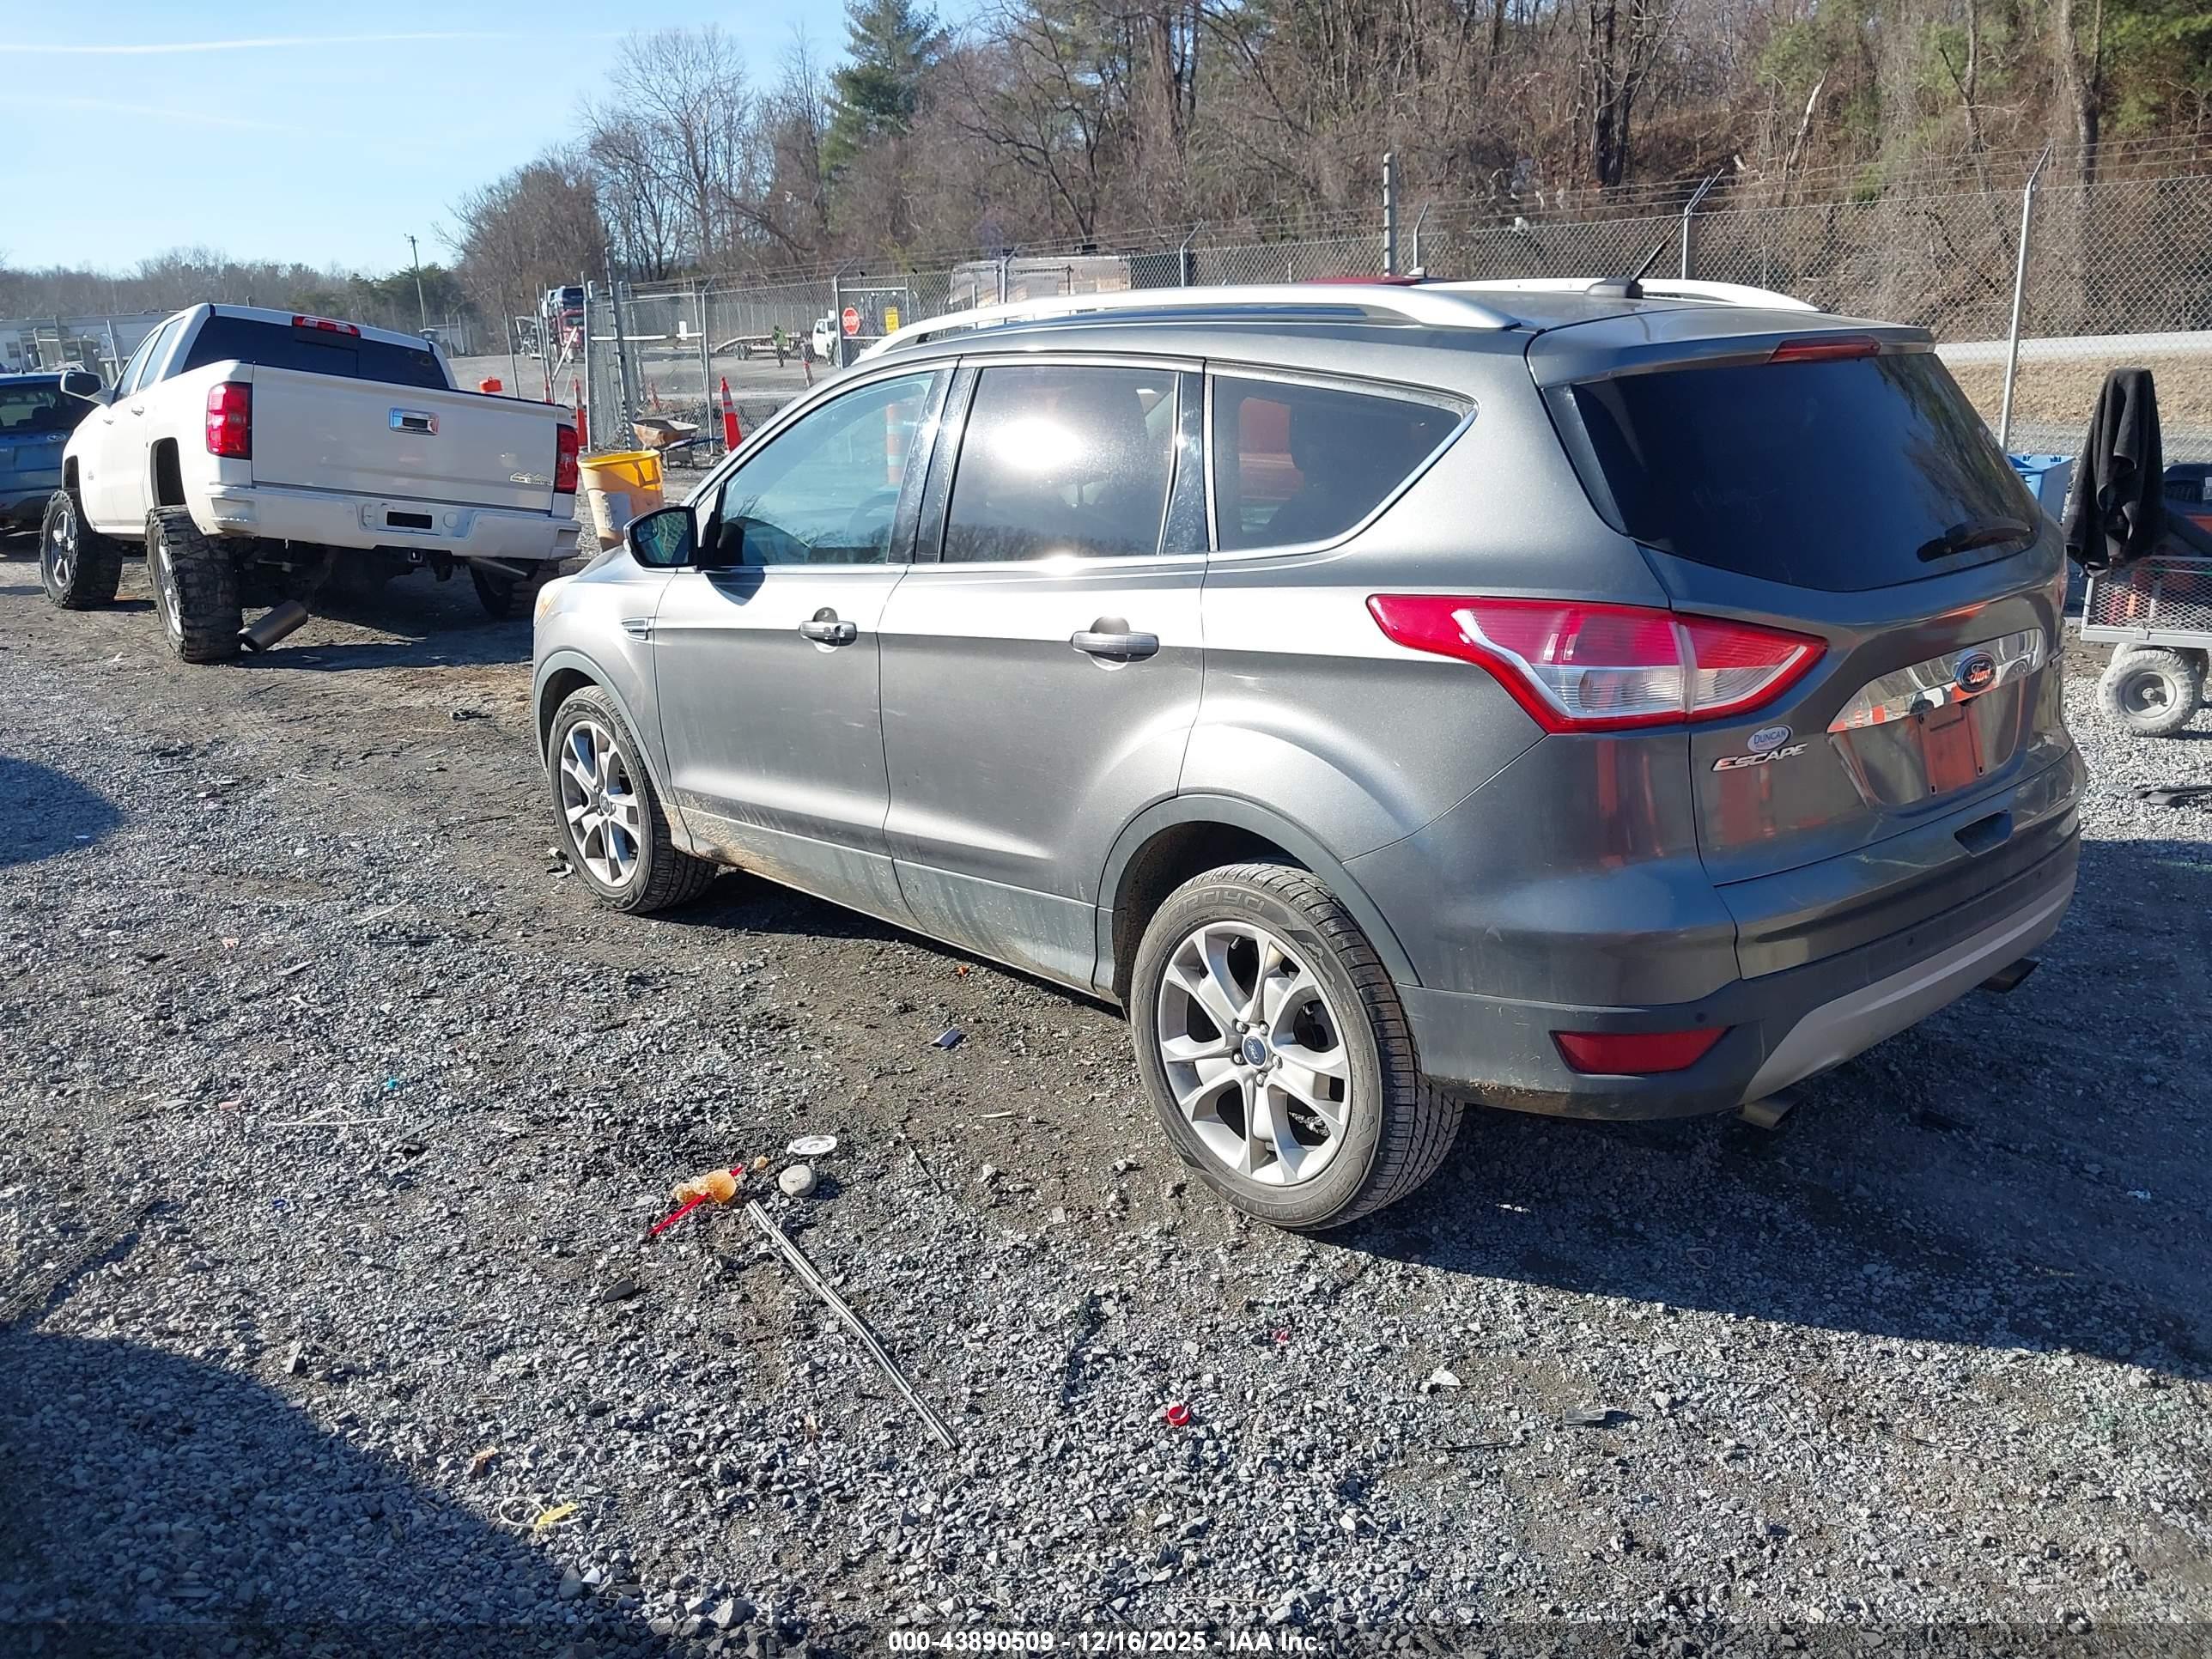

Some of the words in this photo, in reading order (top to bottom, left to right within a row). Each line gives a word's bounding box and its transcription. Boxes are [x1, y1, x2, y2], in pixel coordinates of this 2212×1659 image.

[1968, 661, 1991, 684] Ford
[1753, 730, 1787, 744] DUNCAN
[1712, 743, 1808, 771] ESCAPE
